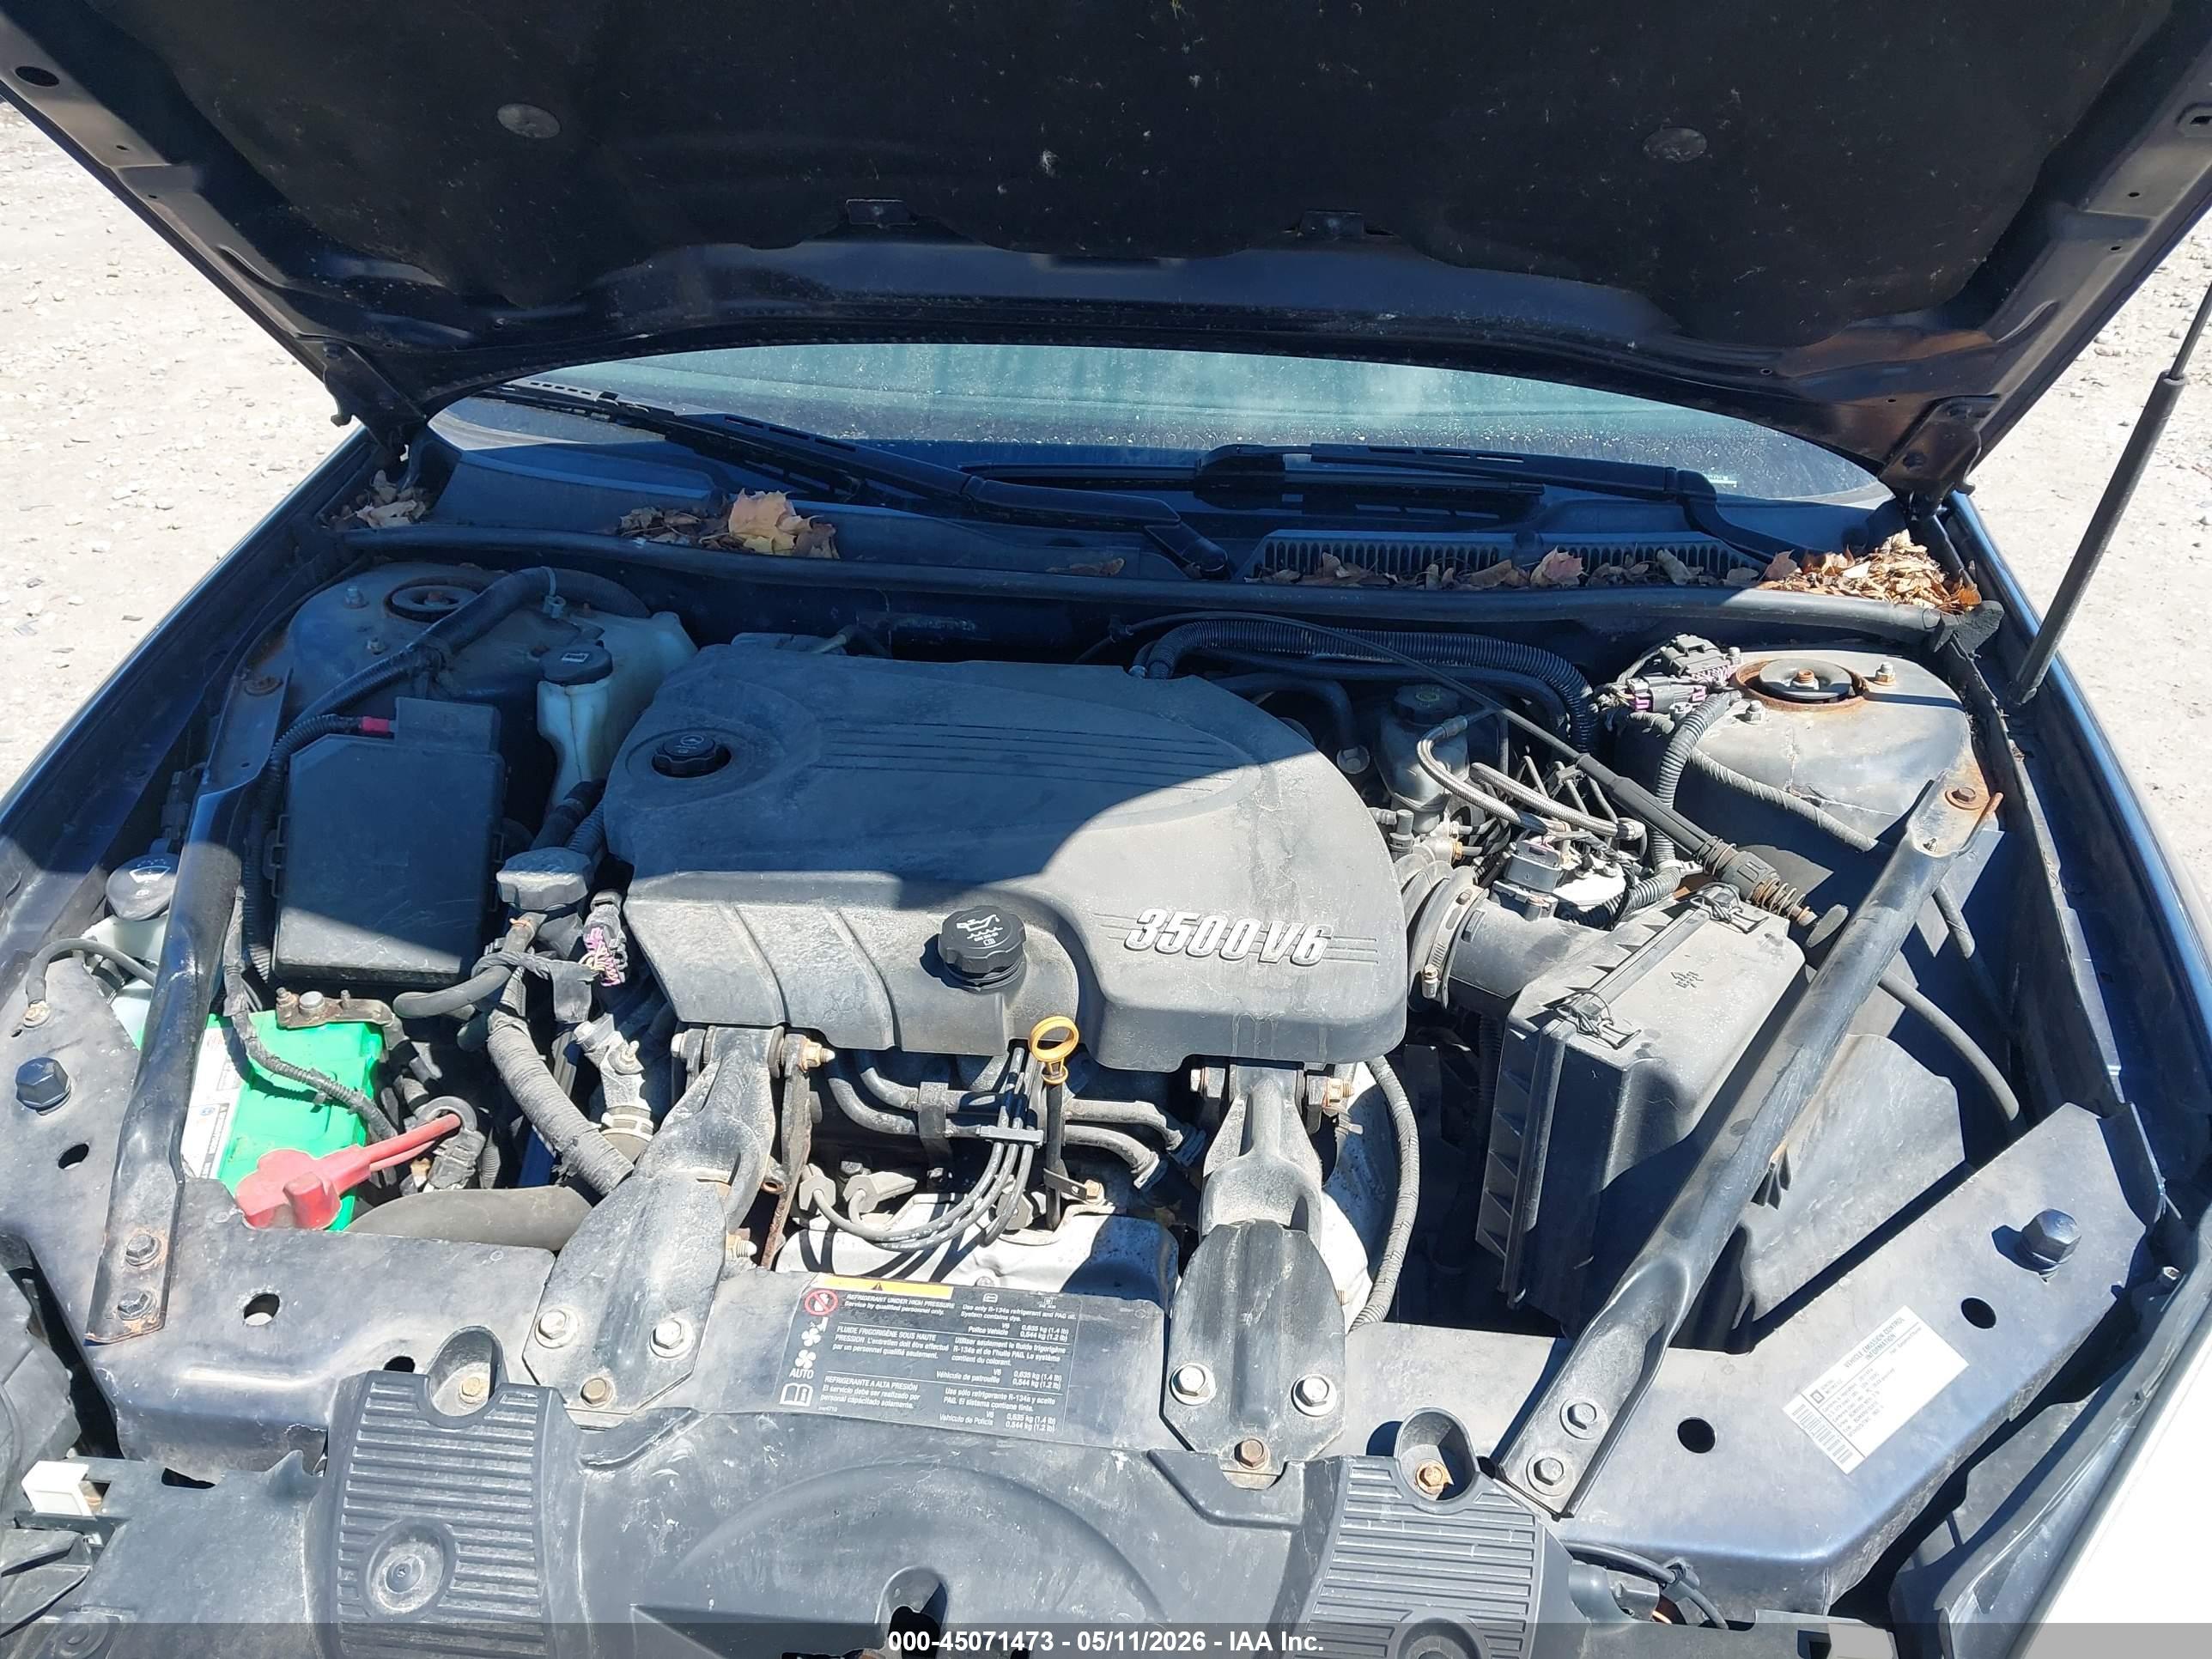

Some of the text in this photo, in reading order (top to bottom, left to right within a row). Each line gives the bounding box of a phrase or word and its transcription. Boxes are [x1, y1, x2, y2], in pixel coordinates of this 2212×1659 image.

[847, 1294, 886, 1303] REFRIGERANT
[925, 1300, 956, 1309] PRESSURE
[902, 1305, 931, 1315] personnel
[961, 1310, 982, 1319] System
[1010, 1309, 1042, 1317] refrigerant
[916, 1333, 937, 1341] HAUTE
[955, 1336, 975, 1345] Utiliser
[977, 1340, 1008, 1348] seulement
[1844, 1351, 1863, 1368] VEHICLE
[1862, 1333, 1885, 1353] EMISSION
[1883, 1317, 1905, 1335] CONTROL
[1865, 1333, 1897, 1360] INFORMATION
[853, 1346, 883, 1355] personnel
[953, 1346, 975, 1354] R-134a
[789, 1368, 814, 1379] AUTO
[1032, 1372, 1041, 1381] kg
[824, 1376, 870, 1387] REFRIGERANTE
[971, 1374, 1000, 1384] patrouille
[1030, 1380, 1039, 1389] kg
[830, 1386, 852, 1395] servicio
[881, 1391, 908, 1400] realizado
[972, 1391, 1007, 1401] refrigerante
[820, 1395, 846, 1403] personal
[847, 1396, 880, 1407] capacitado
[991, 1402, 1018, 1411] contiene
[1025, 1415, 1034, 1424] kg
[1024, 1423, 1033, 1431] kg
